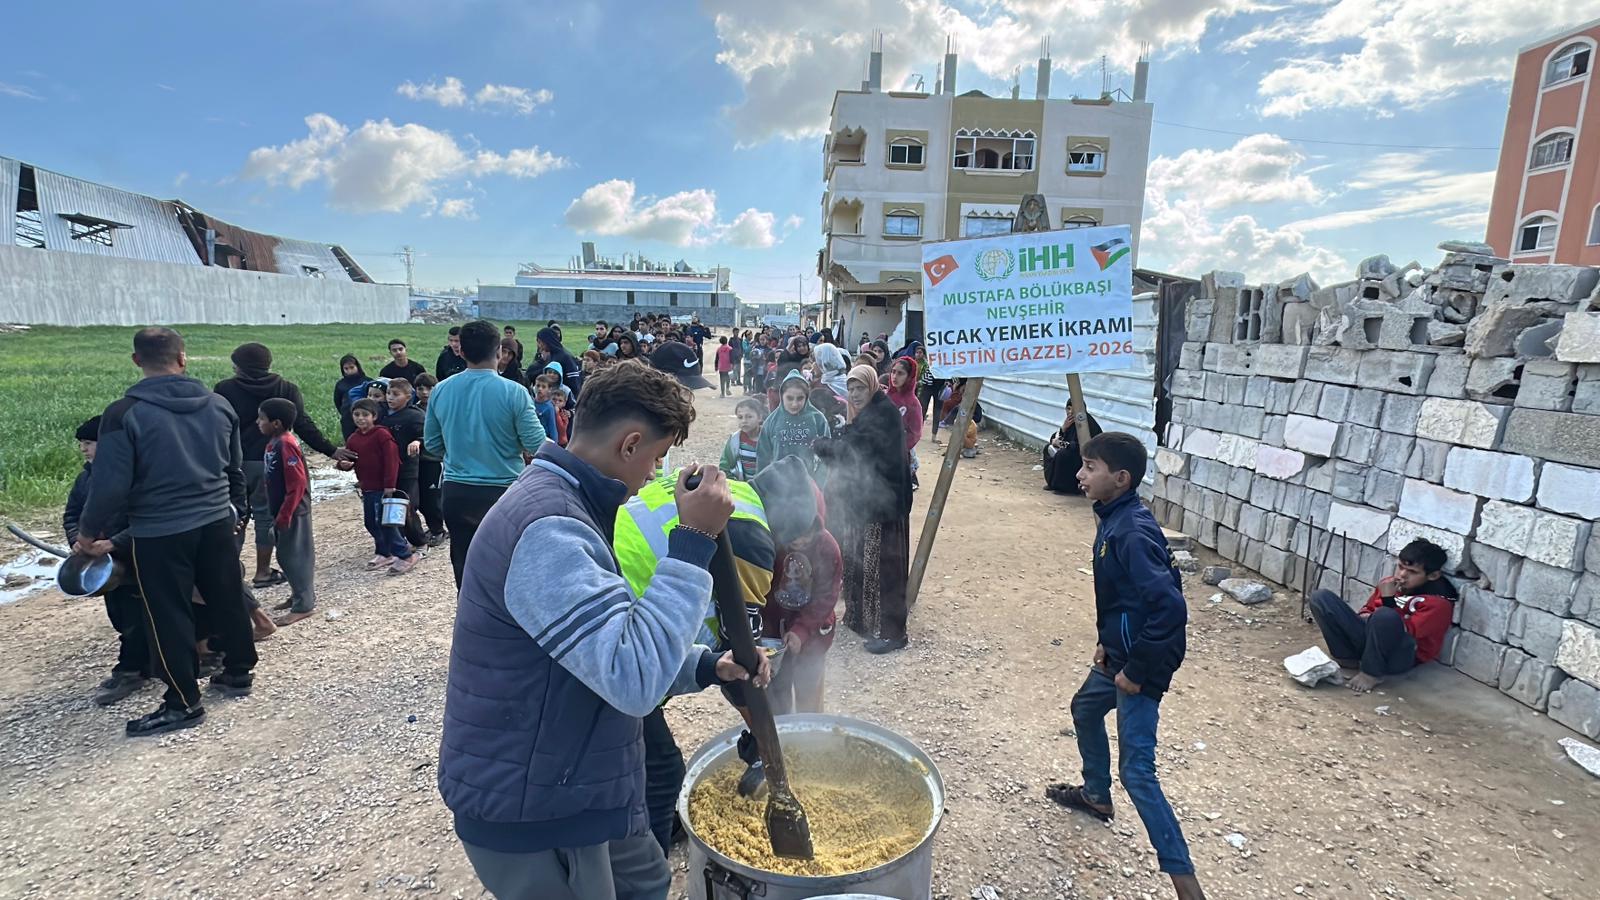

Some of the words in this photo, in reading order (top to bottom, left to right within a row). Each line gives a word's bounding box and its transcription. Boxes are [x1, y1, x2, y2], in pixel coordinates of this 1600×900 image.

[943, 288, 1015, 306] MUSTAFA
[1020, 280, 1111, 299] BÖLÜKBAŞI
[987, 300, 1064, 320] NEVŞEHİR
[927, 328, 982, 347] SICAK
[986, 322, 1053, 342] YEMEK
[1059, 318, 1132, 337] İKRAMI
[928, 347, 996, 366] FİLİSTİN
[1002, 344, 1072, 363] (GAZZE)
[1088, 340, 1133, 356] 2026
